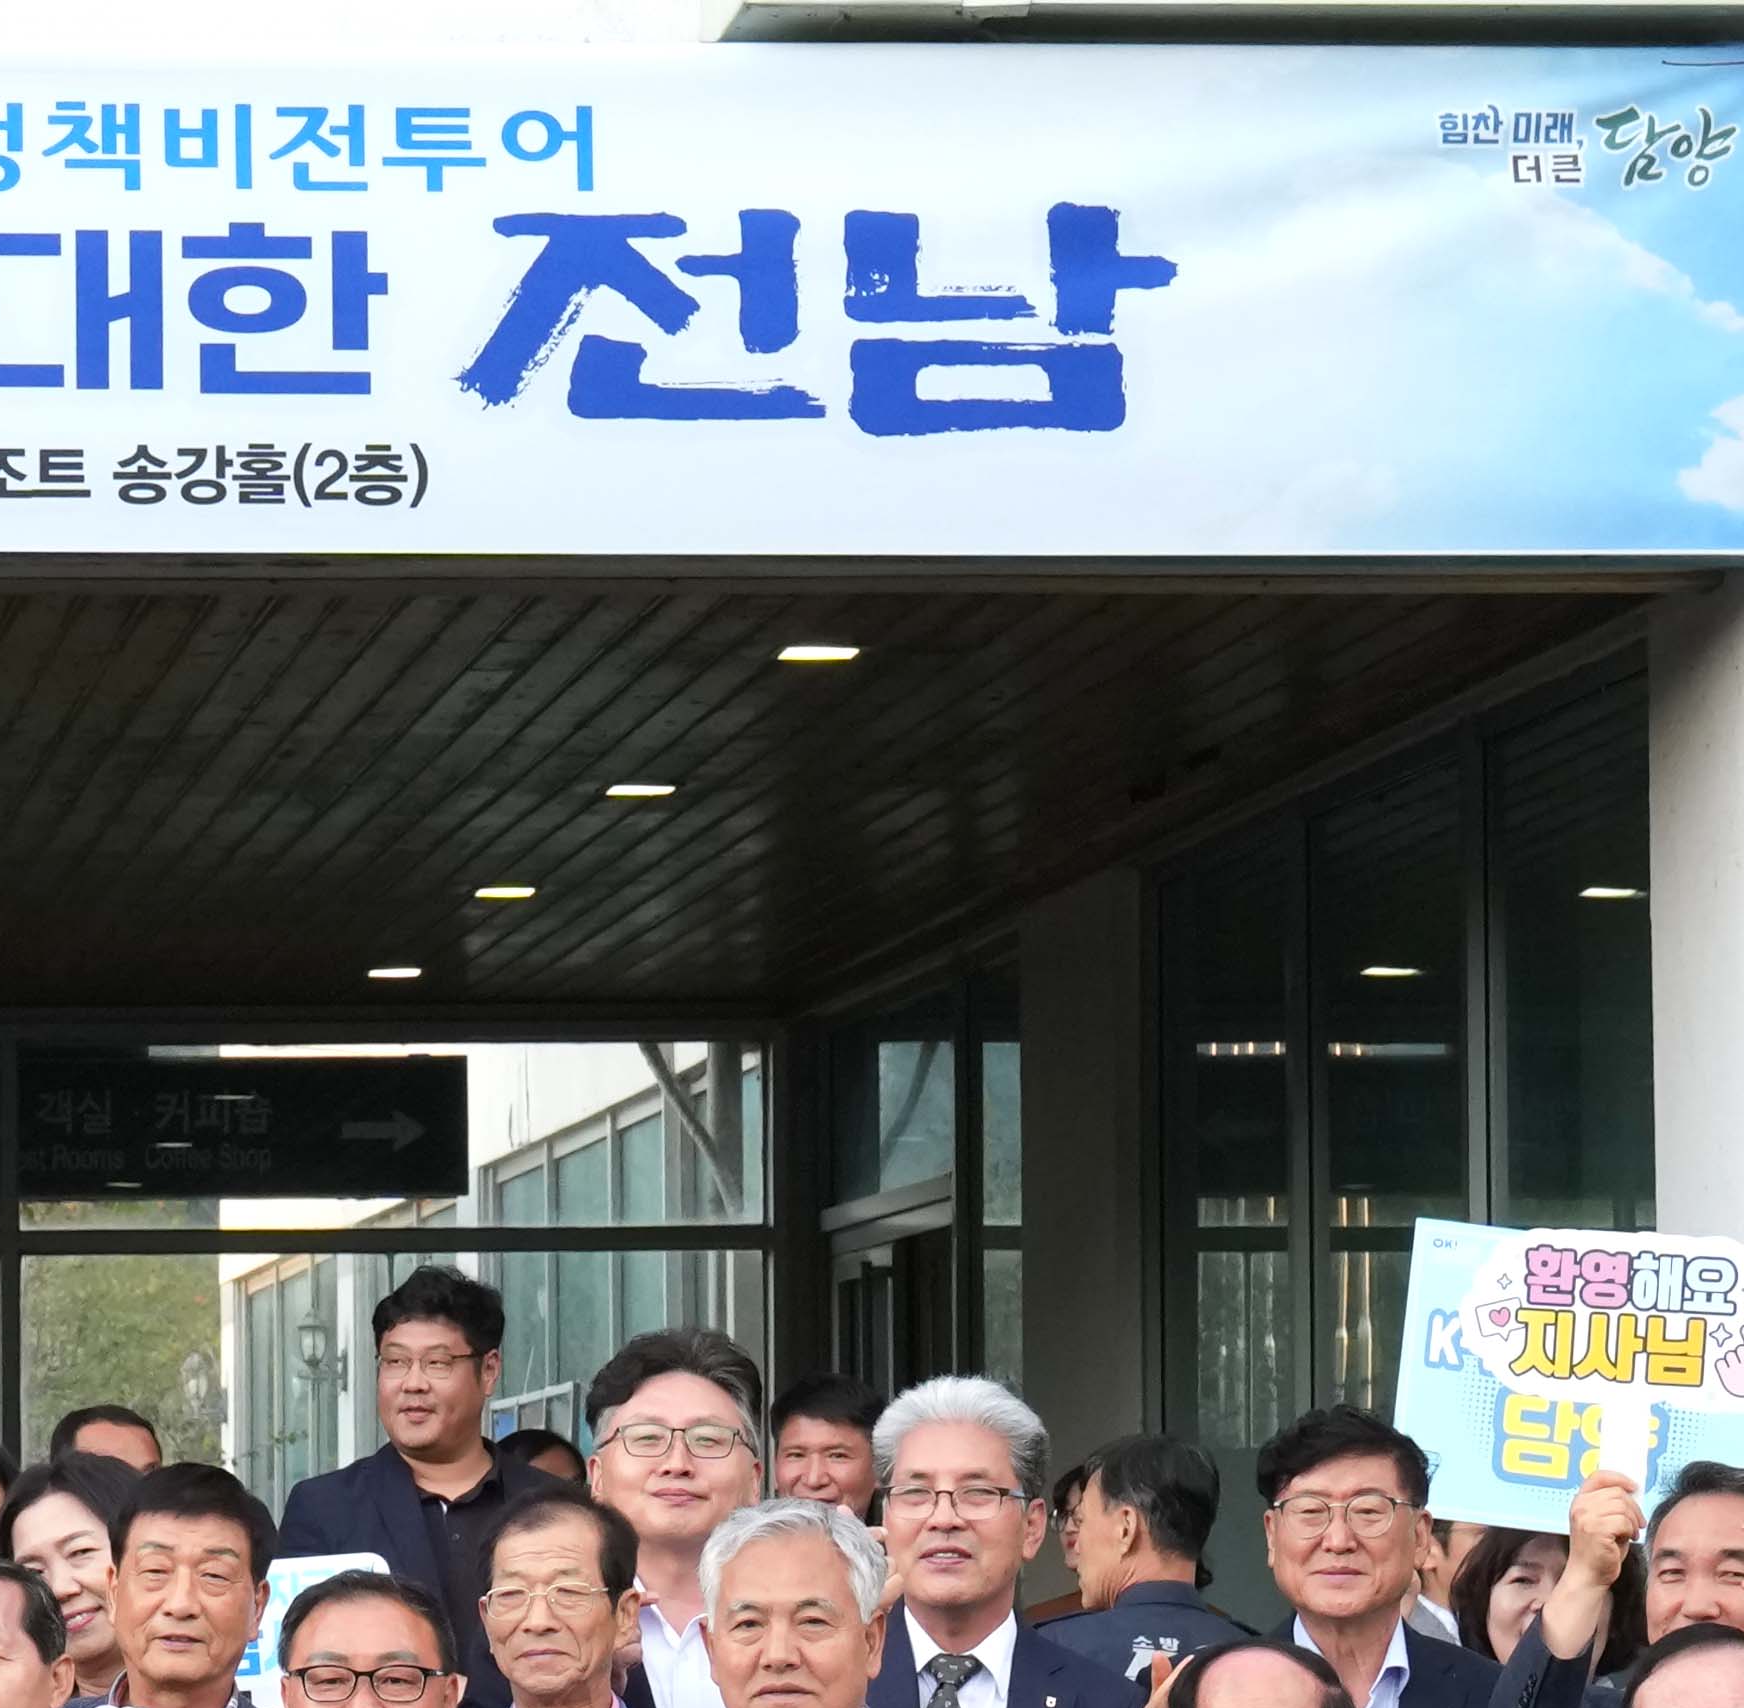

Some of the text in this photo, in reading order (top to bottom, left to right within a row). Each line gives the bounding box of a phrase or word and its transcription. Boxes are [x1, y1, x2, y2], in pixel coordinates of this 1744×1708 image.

[1439, 105, 1583, 149] 힘찬 미래,
[1595, 106, 1737, 187] 담양
[1513, 155, 1582, 183] 더 큰
[457, 202, 1177, 437] 전남
[112, 443, 428, 508] 송강홀(2층)
[1524, 1244, 1739, 1316] 환영해요
[1508, 1307, 1707, 1387] 지사님
